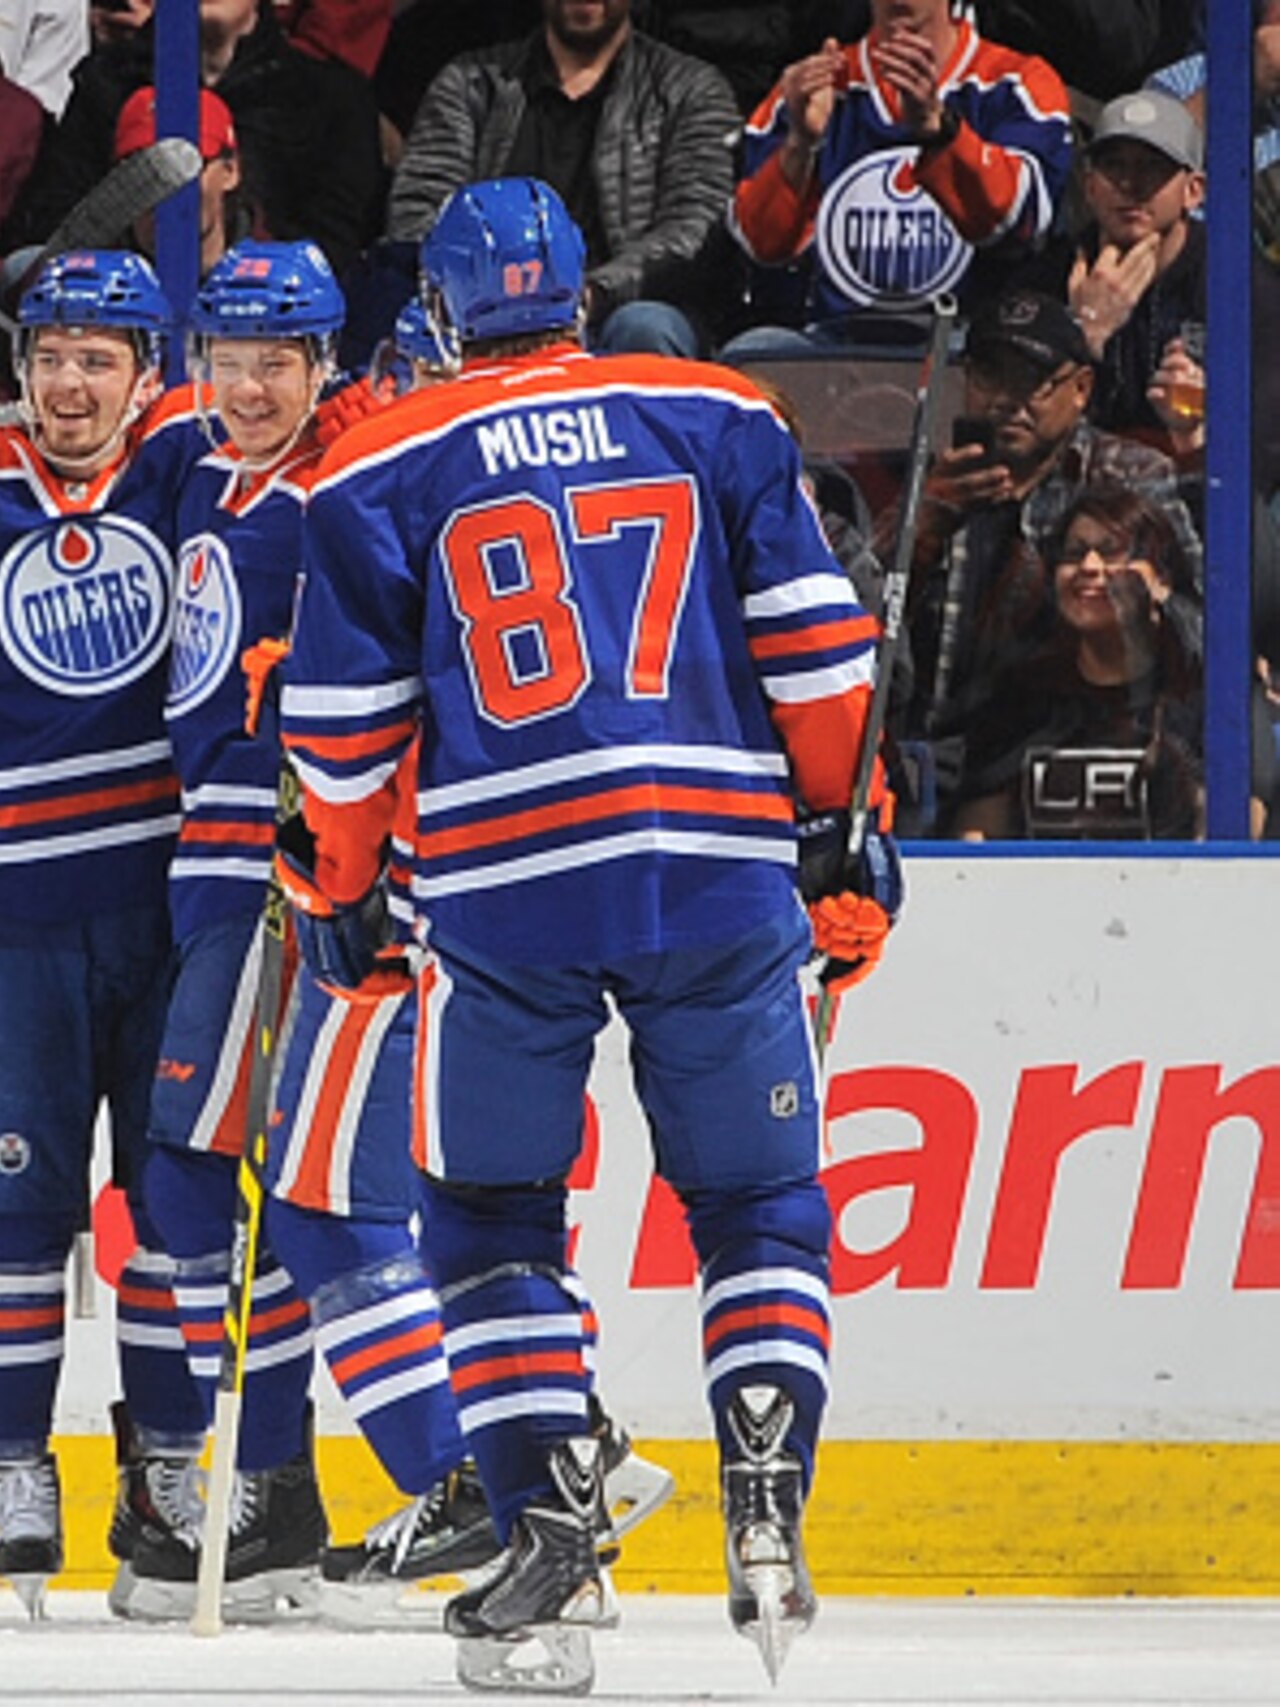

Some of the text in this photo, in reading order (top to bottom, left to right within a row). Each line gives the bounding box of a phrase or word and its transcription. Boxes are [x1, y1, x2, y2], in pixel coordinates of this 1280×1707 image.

[476, 405, 627, 476] MUSIL
[22, 563, 153, 673] OILERS
[439, 475, 699, 729] 87
[1033, 762, 1138, 809] LA
